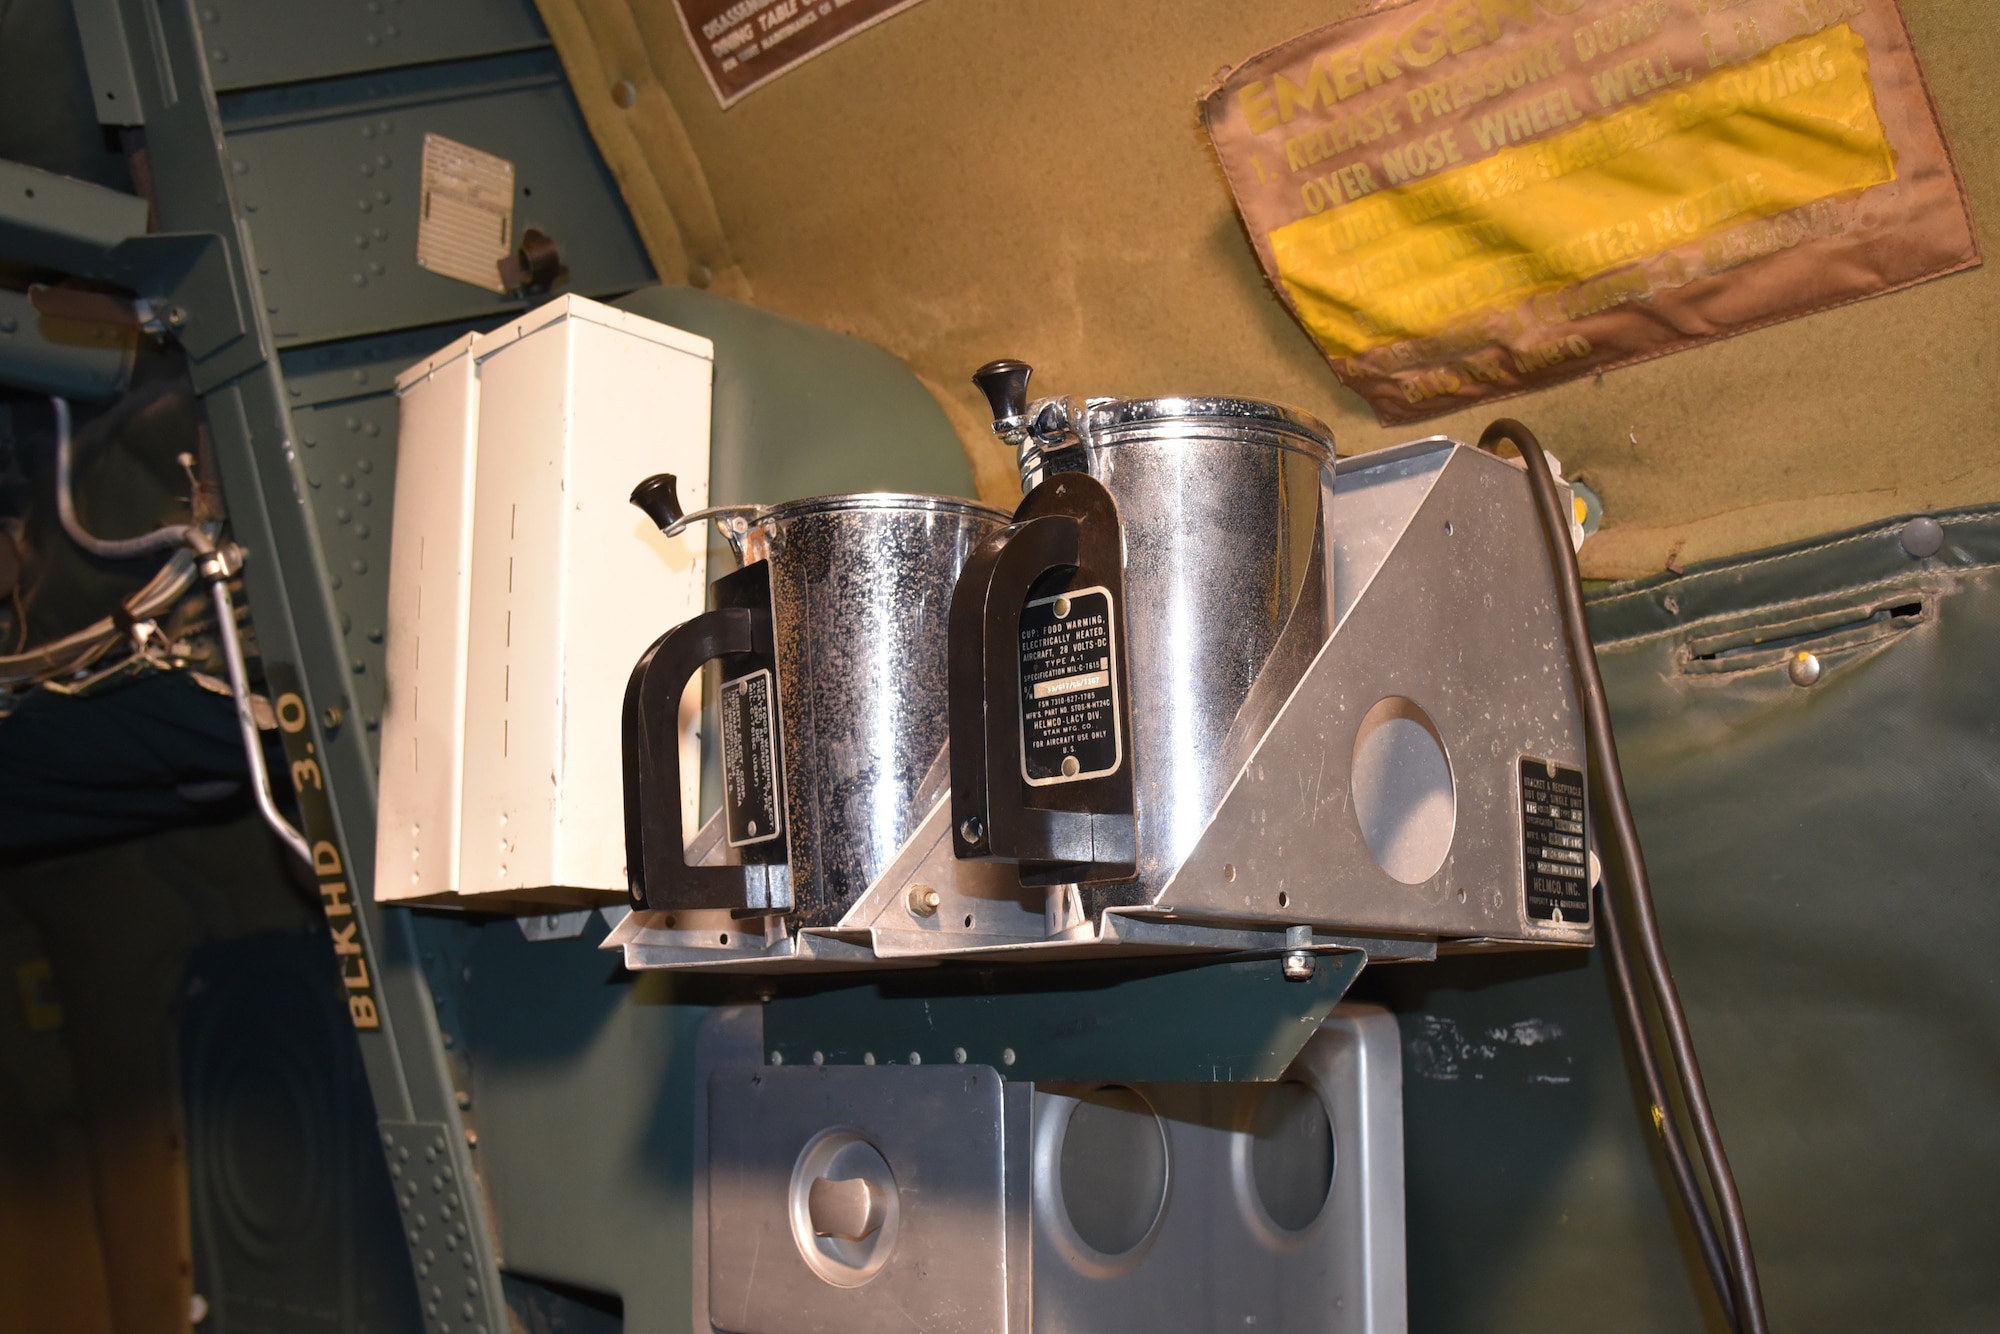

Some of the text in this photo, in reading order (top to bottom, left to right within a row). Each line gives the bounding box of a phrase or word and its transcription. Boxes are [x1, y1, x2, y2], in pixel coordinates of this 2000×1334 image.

[757, 0, 798, 32] TABLE
[1284, 99, 1401, 173] RELEASE
[1407, 38, 1567, 125] PRESSURE
[1301, 161, 1380, 215] OVER
[1381, 128, 1464, 186] NOSE
[1470, 86, 1583, 152] WHEEL
[1590, 50, 1694, 108] WELL,
[1316, 199, 1400, 256] TURN
[1402, 155, 1526, 224] RELEASE
[1714, 44, 1837, 106] SWING
[1043, 623, 1062, 635] FOOD
[1066, 614, 1105, 631] WARMING,
[1022, 626, 1106, 651] ELECTRICALLY HEATED,
[1023, 637, 1107, 662] AIRCRAFT, 28 VOLTS-DC
[1045, 654, 1084, 668] TYPE A-1
[1023, 668, 1066, 682] SPECIFICATION
[734, 688, 742, 729] LIBERTY
[1038, 700, 1050, 709] FSN
[1044, 708, 1058, 717] PART
[1060, 706, 1070, 714] NO.
[1087, 711, 1103, 721] DIV.
[1032, 730, 1107, 749] FOR AIRCRAFT USE ONLY
[1063, 725, 1080, 734] MFG.
[751, 753, 759, 788] (USAF)
[1533, 877, 1581, 896] HELMCO, INC.
[313, 840, 379, 1029] BLKHD
